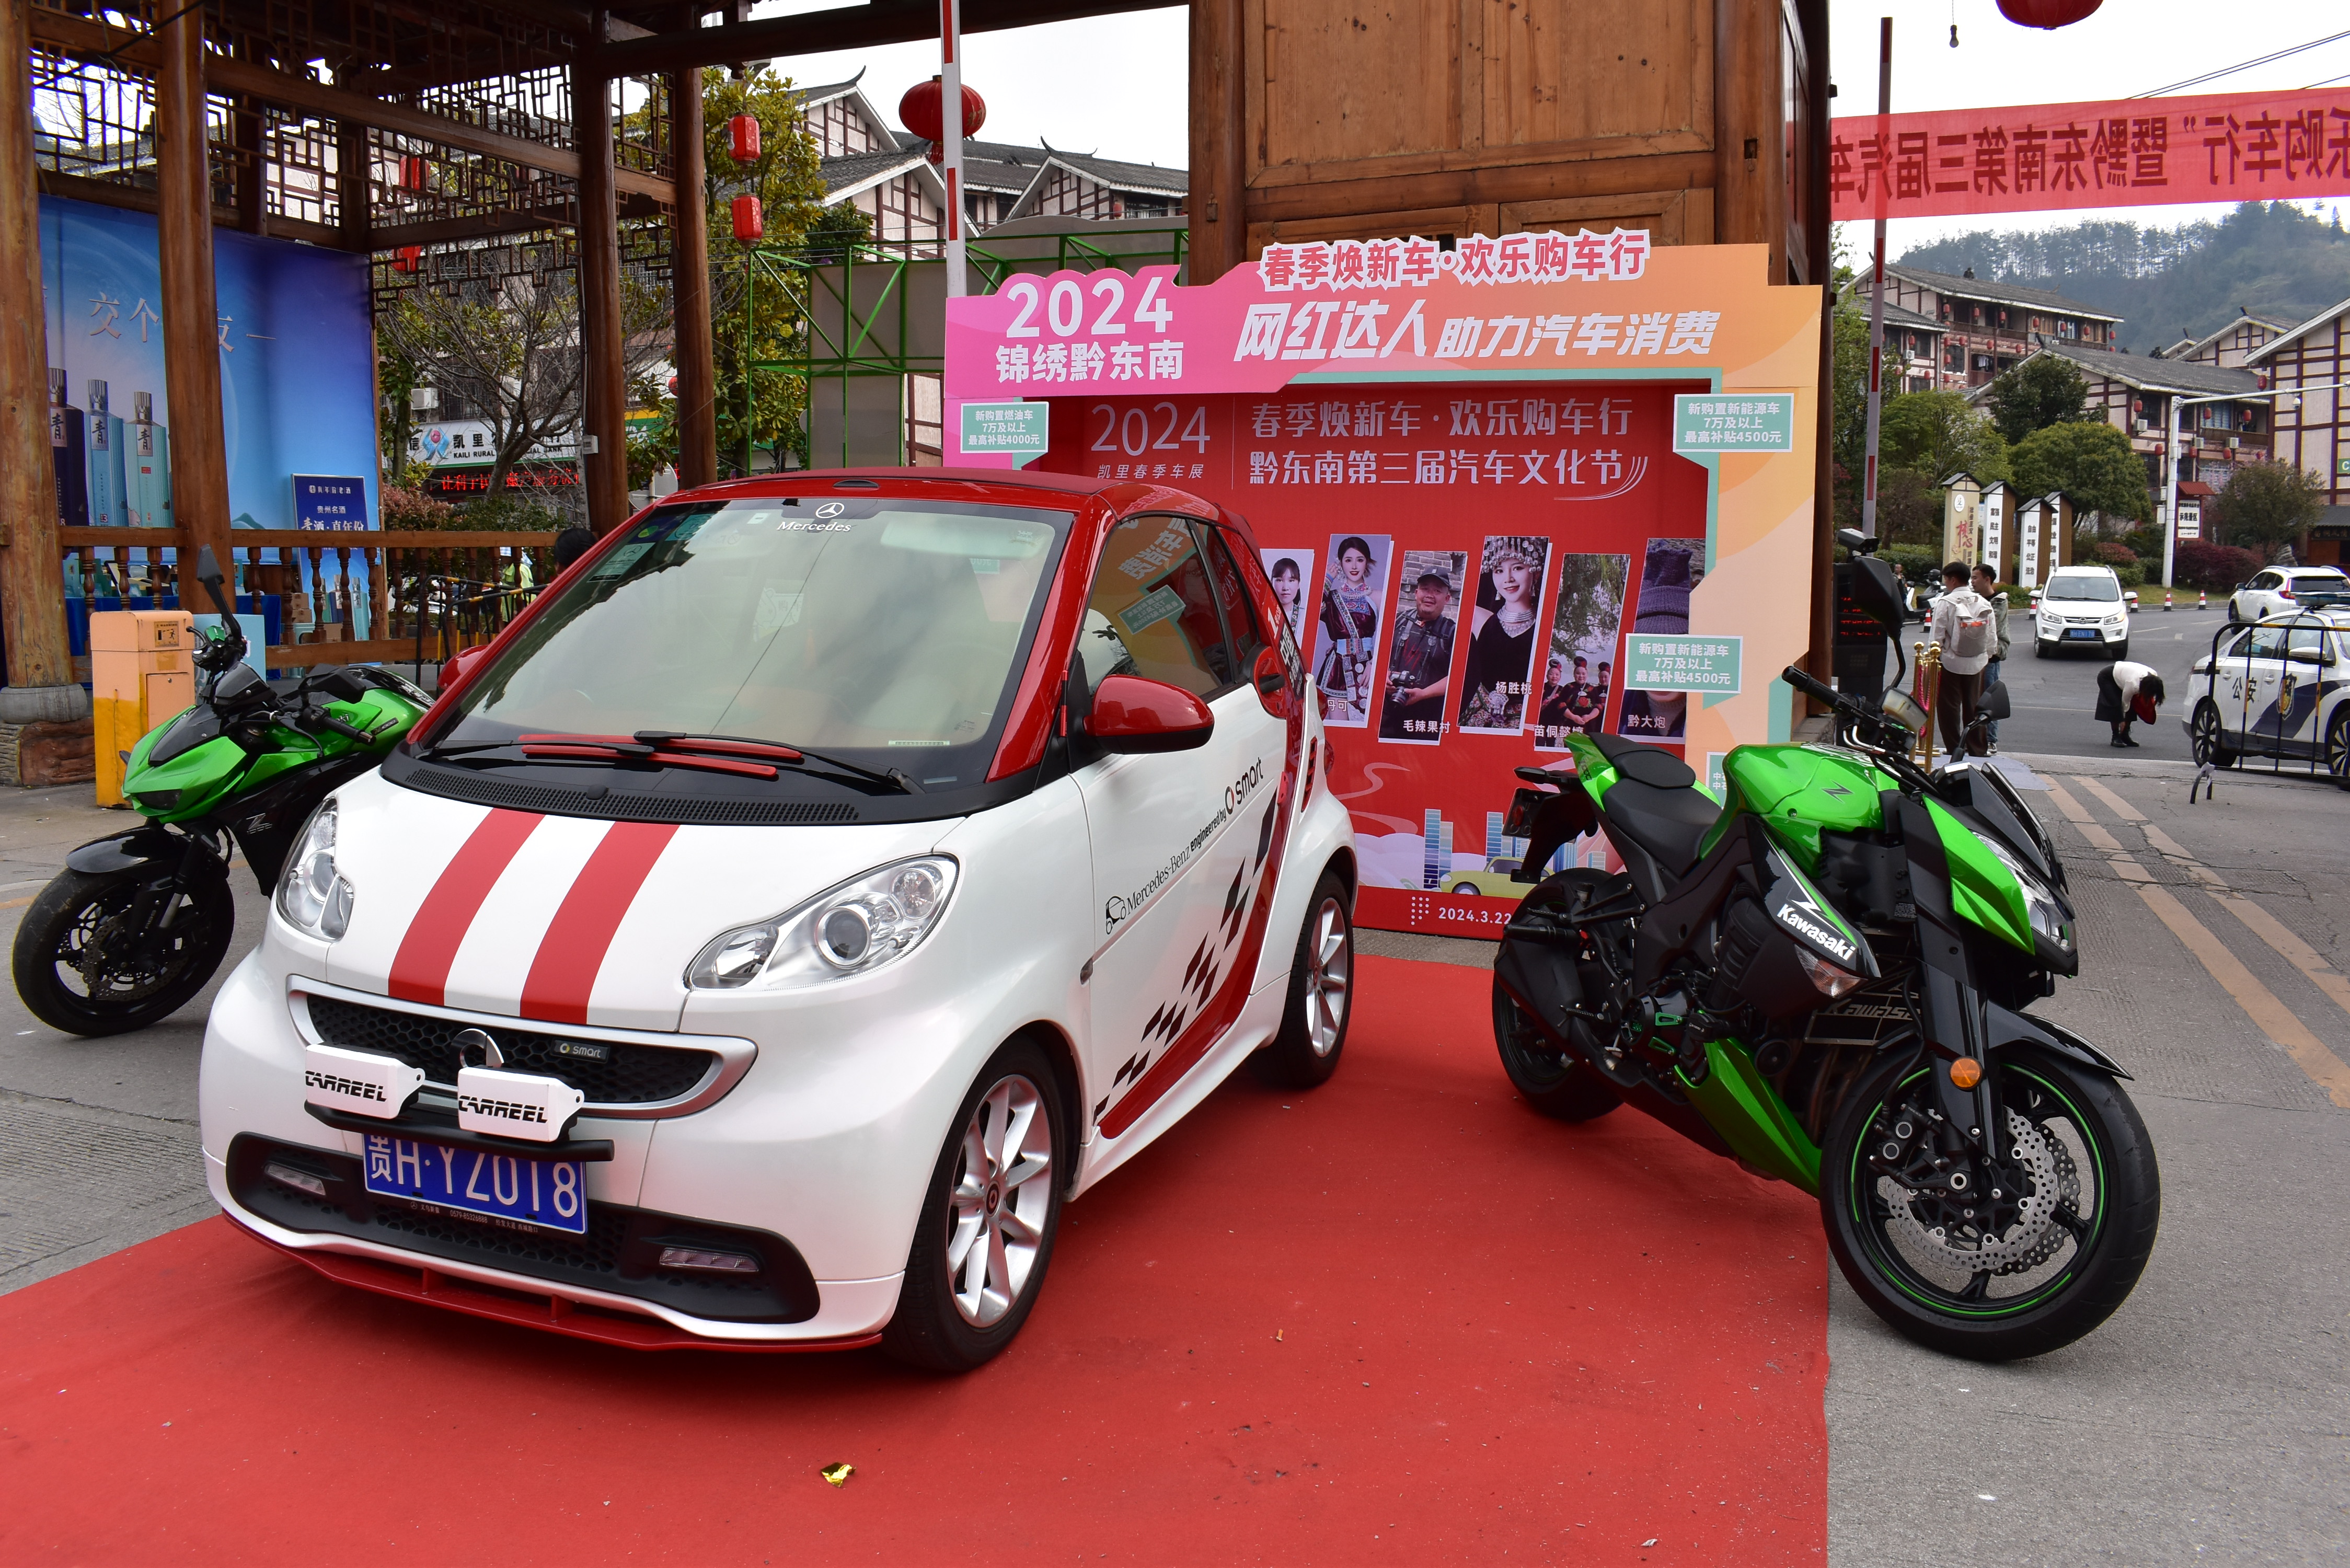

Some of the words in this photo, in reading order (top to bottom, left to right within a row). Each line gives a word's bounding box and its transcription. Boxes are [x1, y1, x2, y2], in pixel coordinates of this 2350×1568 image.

[1007, 276, 1173, 338] 2024
[1234, 299, 1427, 362] 网红达人
[1434, 311, 1721, 358] 助力汽车消费
[995, 339, 1184, 384] 锦绣黔东南
[975, 409, 1033, 421] 新购置燃油车
[1688, 402, 1780, 416] 新购置新能源车
[982, 422, 1026, 433] 7万及以上
[1091, 402, 1210, 456] 2024
[1704, 417, 1763, 429] 7万及以上
[92, 420, 105, 444] 青
[138, 428, 150, 450] 青
[969, 433, 1040, 445] 最高补贴4000元
[1684, 431, 1782, 444] 最高补贴4500元
[1098, 463, 1204, 479] 凯里春季车展
[1250, 448, 1622, 485] 黔东南第三届汽车文化节
[317, 505, 347, 514] 贵州名酒
[776, 521, 851, 532] Mercedes
[1989, 522, 1999, 531] 民主
[2028, 525, 2036, 534] 自由
[1988, 536, 1999, 545] 文明
[1639, 642, 1729, 657] 新购置新能源车
[1654, 658, 1712, 670] 7万及以上
[1635, 670, 1731, 685] 最高补贴4500元
[1495, 681, 1533, 695] 杨胜桃
[1403, 719, 1451, 734] 毛辣果村
[1627, 714, 1666, 729] 黔大炮
[1235, 757, 1264, 805] smart
[1126, 845, 1191, 916] Mercedes-Benz
[1776, 903, 1856, 961] Kawasaki
[572, 1045, 602, 1059] smart
